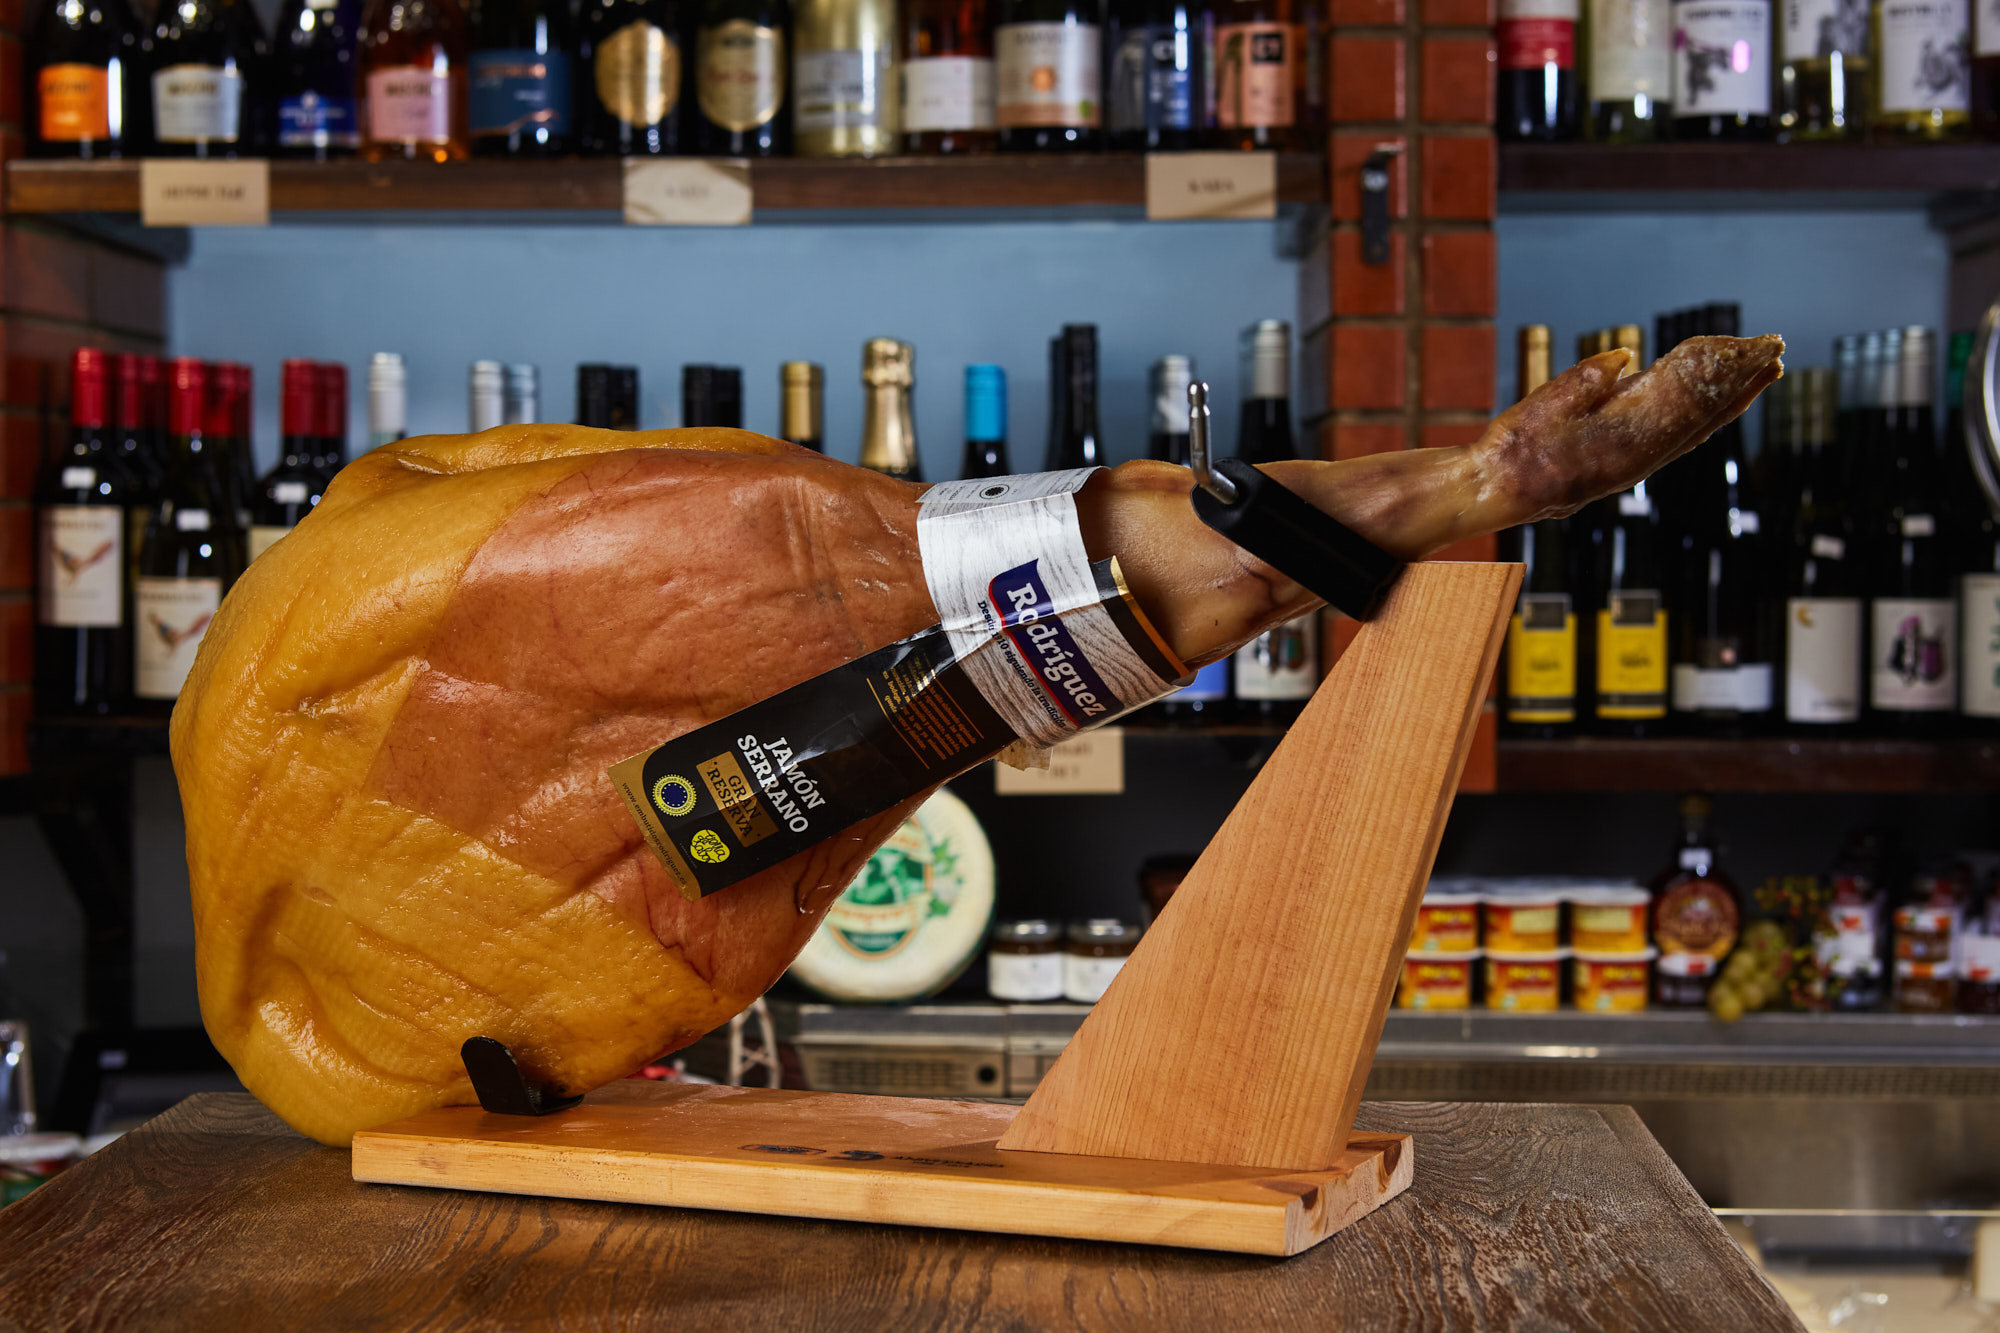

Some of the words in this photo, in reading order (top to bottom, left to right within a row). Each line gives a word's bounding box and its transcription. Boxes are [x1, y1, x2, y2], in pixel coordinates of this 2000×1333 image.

[1005, 647, 1035, 689] siguiendo
[1032, 686, 1042, 697] la
[1038, 694, 1067, 728] tradición
[1006, 582, 1107, 717] Rodríguez
[706, 767, 754, 838] RESERVA
[728, 774, 762, 818] GRAN
[737, 734, 809, 833] SERRANO
[763, 736, 826, 810] JAMÓN
